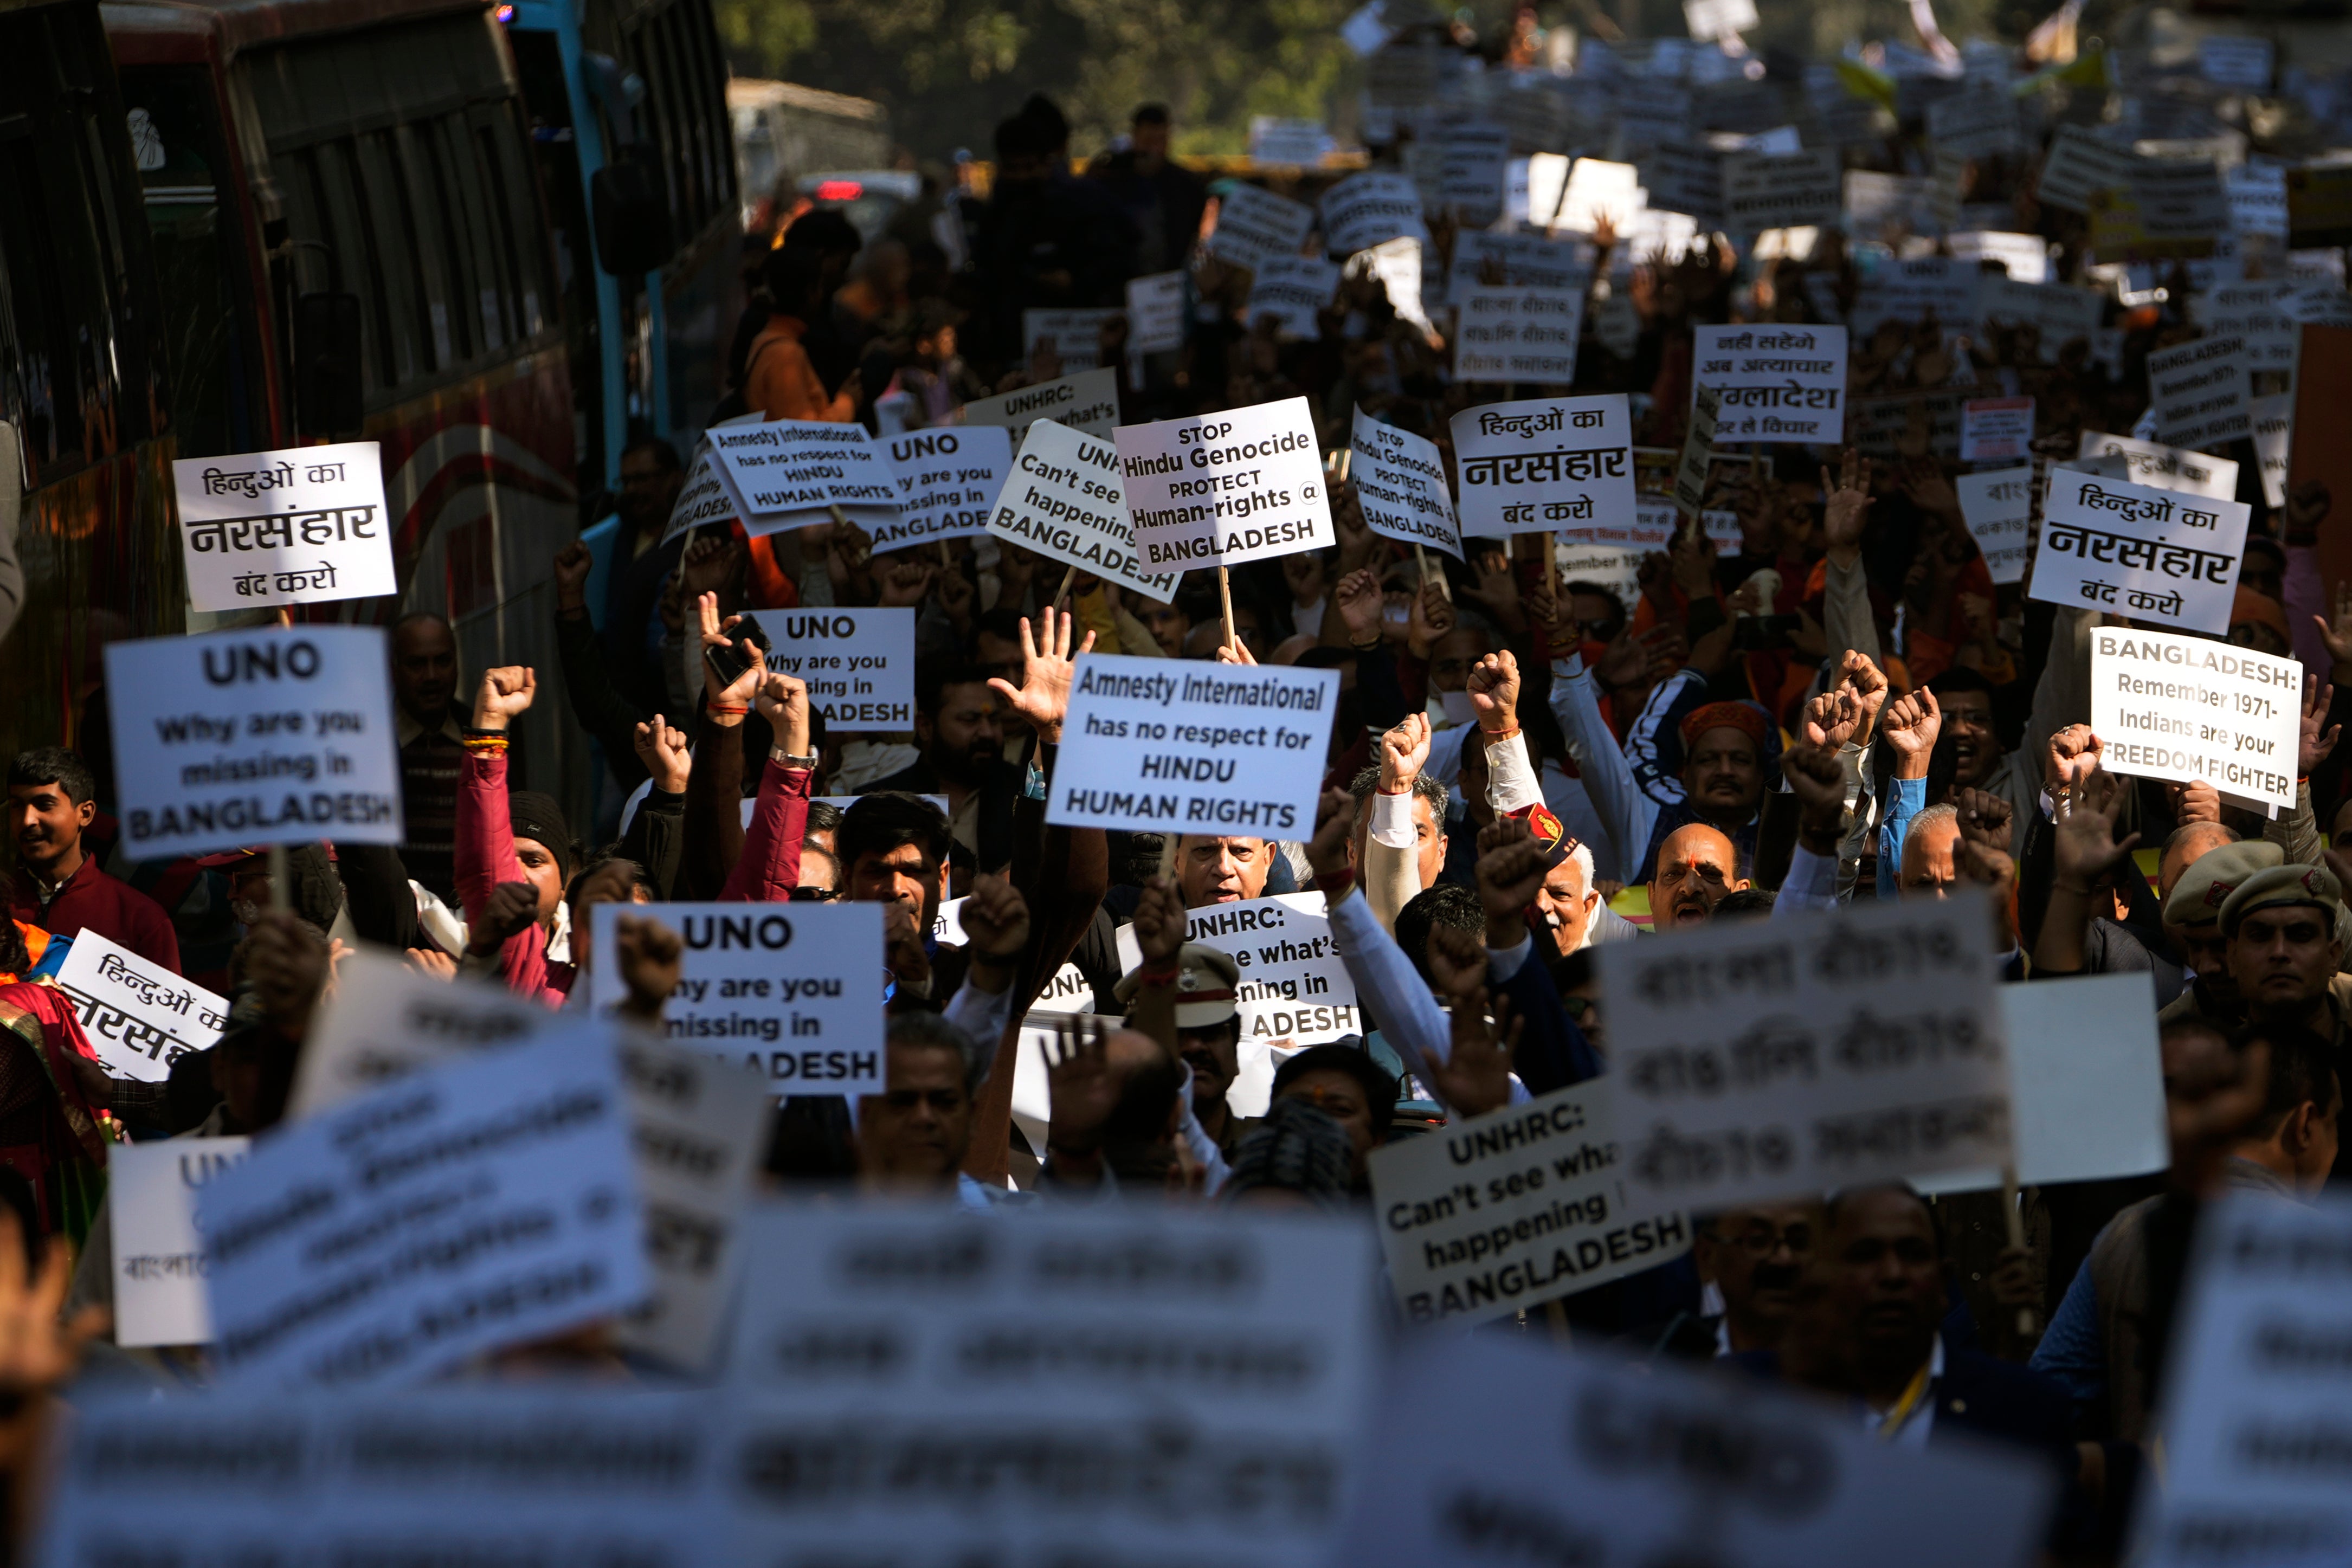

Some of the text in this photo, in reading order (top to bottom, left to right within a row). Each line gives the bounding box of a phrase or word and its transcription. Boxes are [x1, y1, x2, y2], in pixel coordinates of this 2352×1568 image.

[1702, 359, 1834, 373] अब अत्याचार
[1005, 385, 1074, 416] UNHRC:
[718, 425, 865, 448] Amnesty International
[1178, 422, 1233, 444] STOP
[1376, 429, 1404, 448] STOP
[1479, 407, 1604, 438] हिन्दुओं का
[737, 448, 872, 467] has no respect for
[892, 434, 958, 461] UNO
[1122, 430, 1310, 478] Hindu Genocide
[1353, 432, 1445, 483] Hindu Genocide
[1461, 444, 1628, 487] नरसंहार
[202, 462, 345, 498] हिन्दुओं का
[784, 465, 844, 482] HINDU
[920, 470, 951, 486] are
[957, 468, 992, 482] you
[1021, 453, 1120, 504] Can't see
[1169, 469, 1261, 499] PROTECT
[1375, 468, 1427, 493] PROTECT
[753, 485, 894, 506] HUMAN RIGHTS
[898, 488, 983, 512] ssing in
[1132, 480, 1320, 529] Human-rights @
[1355, 474, 1444, 518] Human-rights
[1501, 494, 1594, 525] बंद करो
[2079, 483, 2219, 531] हिन्दुओं का
[185, 504, 377, 553] नरसंहार
[874, 510, 989, 544] ANGLADE
[1148, 518, 1315, 564] BANGLADESH
[1364, 506, 1458, 550] BANGLADESH
[2048, 521, 2237, 584] नरसंहार
[233, 560, 337, 597] बंद करो
[2080, 579, 2185, 616] बंद करो
[787, 616, 855, 638] UNO
[201, 639, 321, 686] UNO
[809, 655, 841, 669] are
[848, 655, 887, 672] you
[2098, 636, 2297, 691] BANGLADESH:
[807, 677, 873, 696] sing in
[1078, 666, 1325, 711] Amnesty International
[2118, 673, 2278, 719] Remember 1971-
[156, 709, 362, 745] Why are you
[823, 703, 908, 722] ADESH
[1085, 713, 1312, 750] has no respect for
[2119, 708, 2274, 756] Indians are your
[181, 748, 352, 786] missing in
[1140, 754, 1236, 782] HINDU
[2208, 759, 2289, 796] FIGHTER
[127, 791, 392, 843] BANGLADESH
[1066, 788, 1296, 828] HUMAN RIGHTS
[683, 914, 792, 950] UNO
[98, 953, 196, 1016] हिन्दुओं
[719, 978, 772, 997] are
[779, 977, 841, 1003] you
[1304, 972, 1328, 995] in
[792, 1011, 820, 1037] in
[1253, 1004, 1352, 1036] ADESH
[1448, 1102, 1584, 1166] UNHRC:
[1387, 1182, 1479, 1233] Can't
[1487, 1165, 1545, 1204] see
[1423, 1192, 1607, 1270] happening
[1406, 1209, 1685, 1323] BANGLADESH
